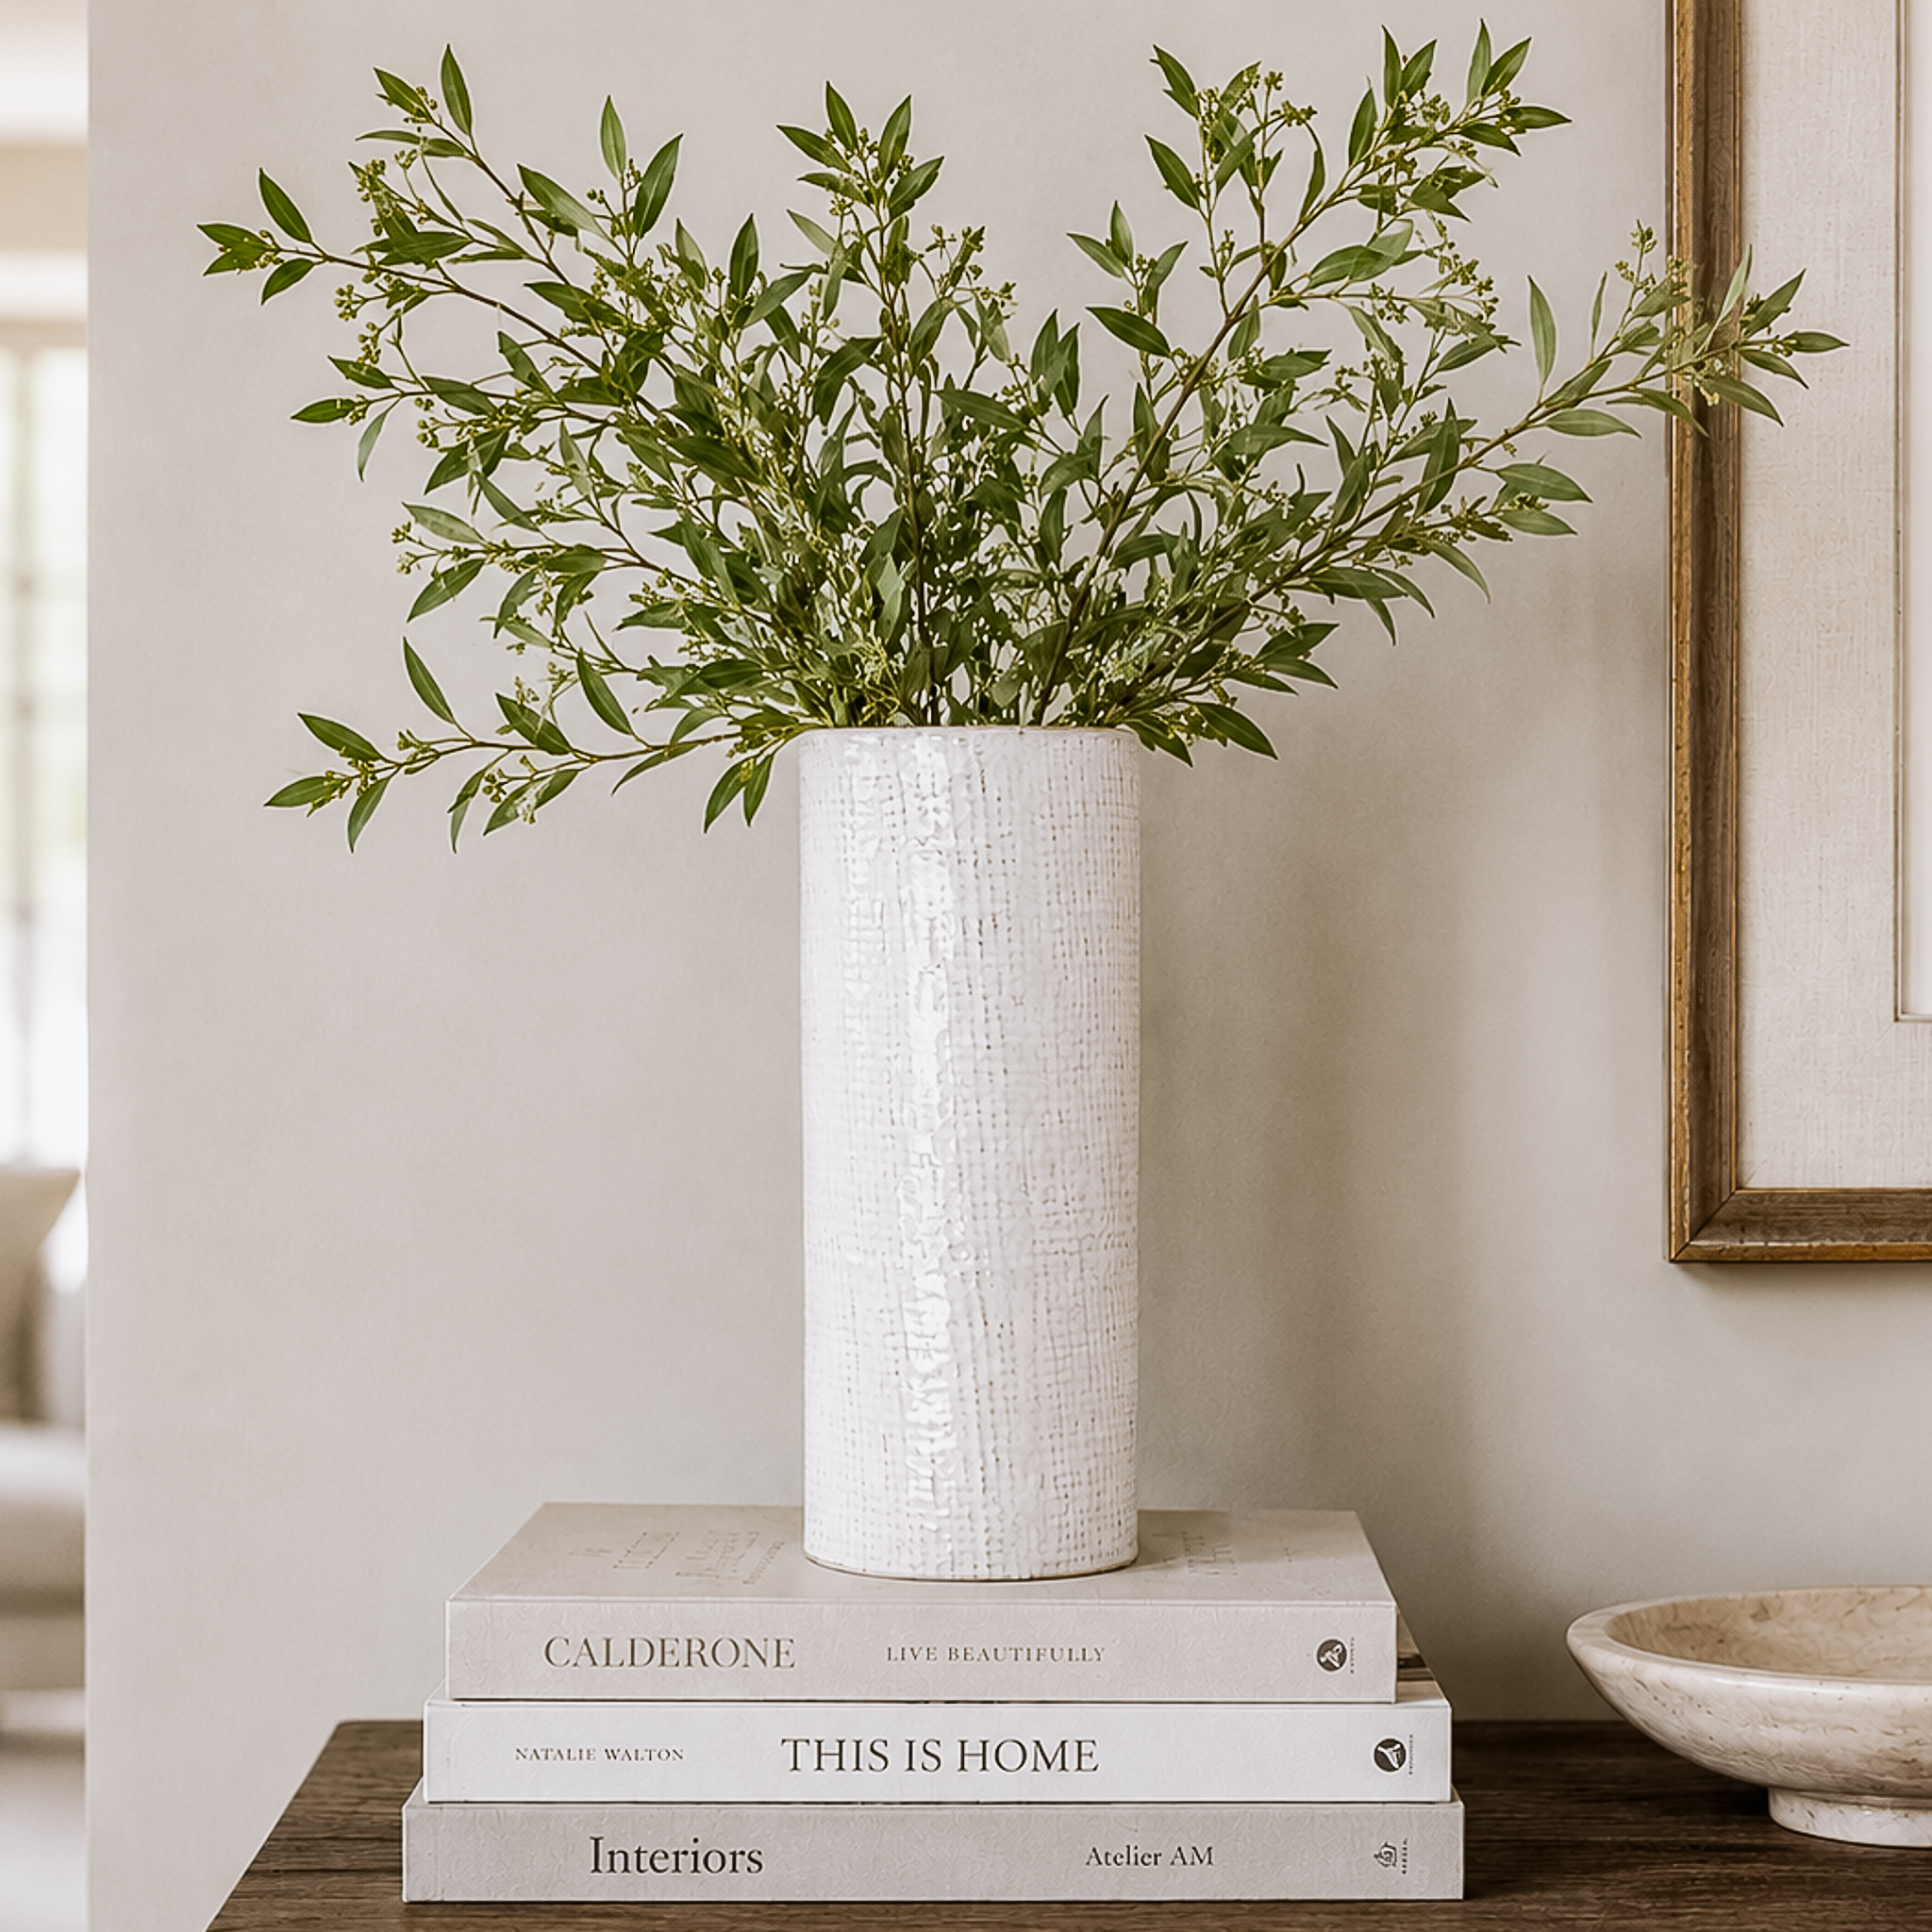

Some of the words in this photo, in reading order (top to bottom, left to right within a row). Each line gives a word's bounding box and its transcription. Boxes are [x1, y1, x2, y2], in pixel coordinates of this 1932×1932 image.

[544, 1636, 796, 1669] CALDERONE
[887, 1646, 938, 1662] LIVE
[948, 1646, 1106, 1662] BEAUTIFULLY
[515, 1747, 597, 1761] NATALIE
[604, 1747, 684, 1762] WALTON
[781, 1738, 890, 1774] THIS
[904, 1738, 941, 1774] IS
[957, 1738, 1099, 1774] HOME
[590, 1836, 764, 1874] Interiors
[1085, 1844, 1163, 1867] Atelier
[1169, 1845, 1215, 1867] AM
